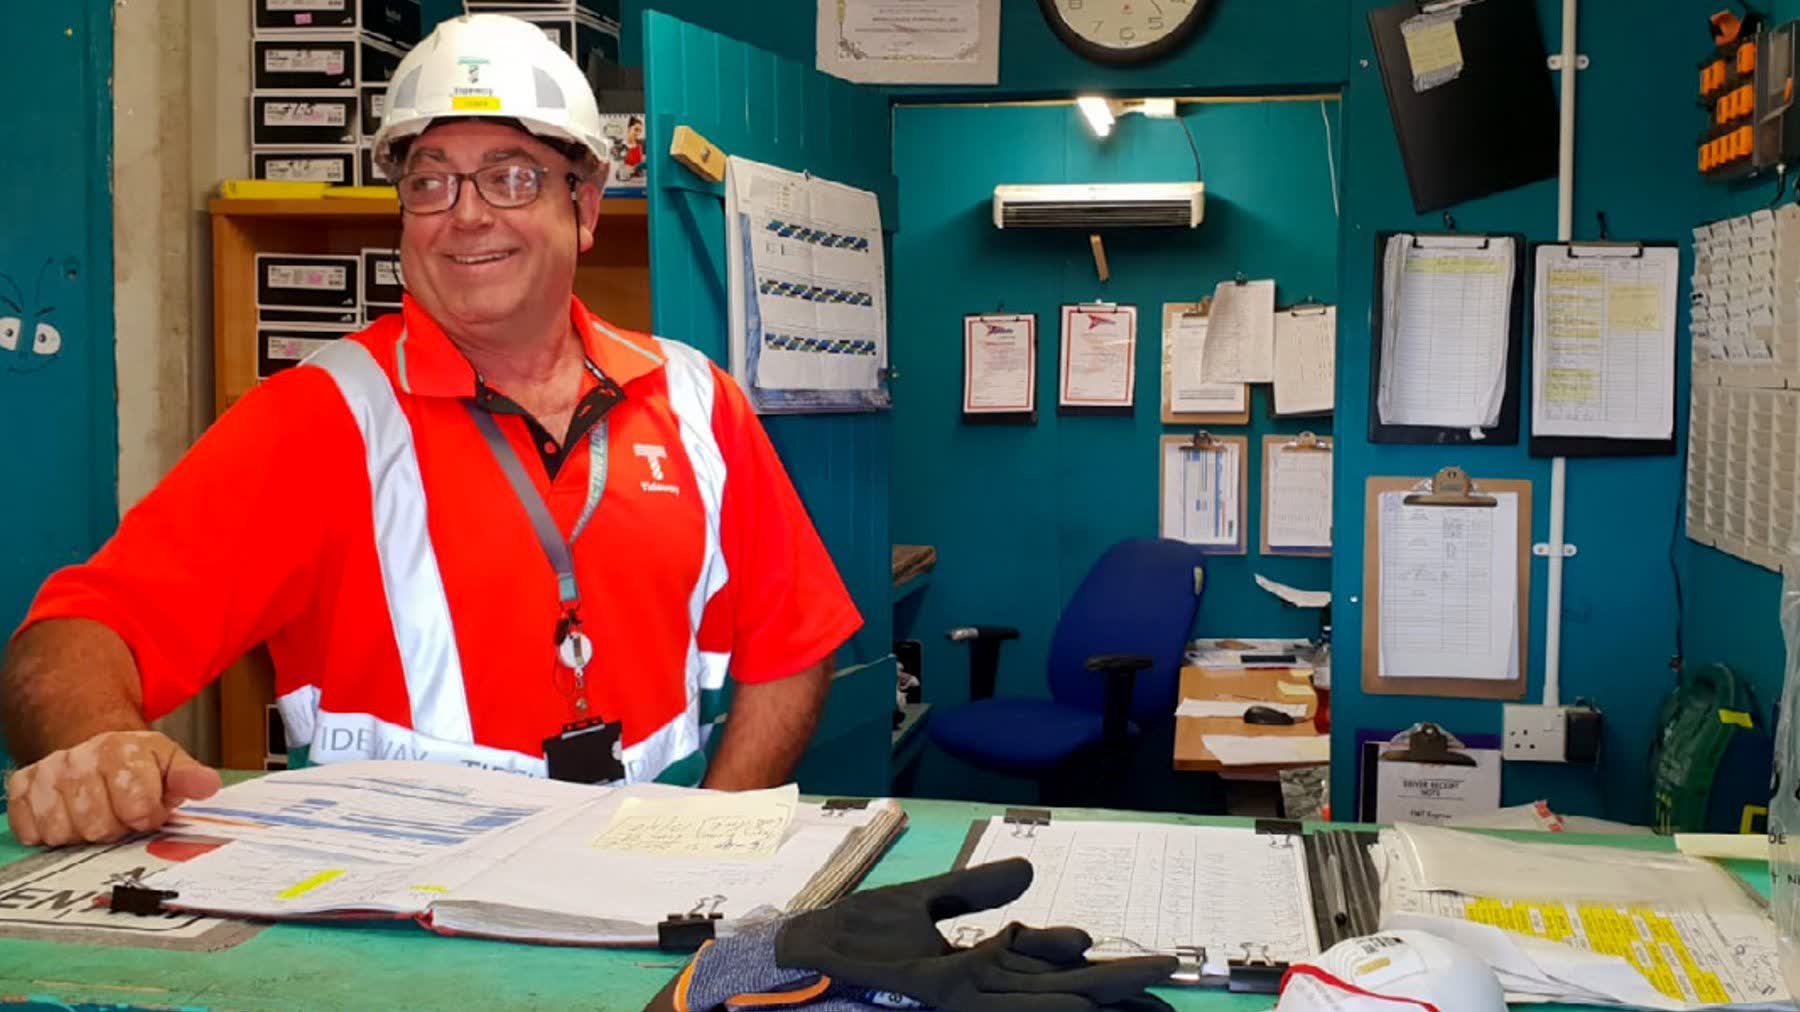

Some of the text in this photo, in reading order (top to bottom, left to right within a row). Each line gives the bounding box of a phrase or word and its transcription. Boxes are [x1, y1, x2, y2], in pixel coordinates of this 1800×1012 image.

[1093, 20, 1104, 34] 7
[1148, 16, 1164, 31] 5
[1119, 27, 1136, 41] 6
[320, 726, 429, 761] IDEWAY
